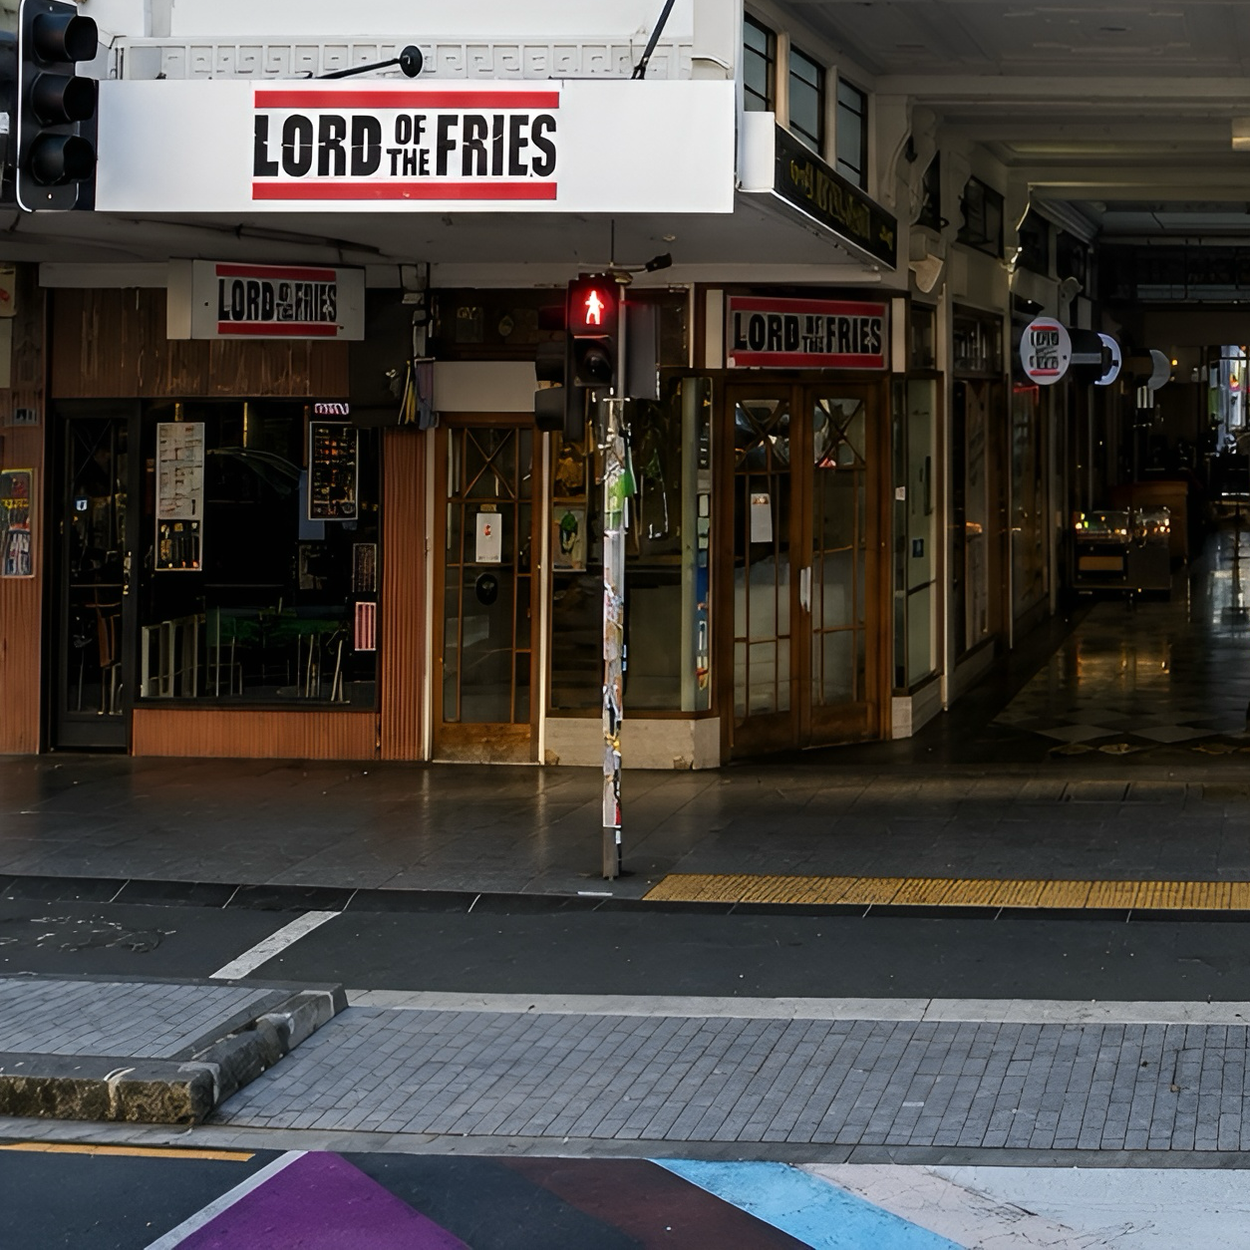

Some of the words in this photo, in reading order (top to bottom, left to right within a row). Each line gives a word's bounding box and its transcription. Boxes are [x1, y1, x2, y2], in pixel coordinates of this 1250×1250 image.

[253, 114, 383, 178] LORD
[395, 113, 427, 146] OF
[435, 113, 557, 178] FRIES
[386, 148, 431, 177] THE
[218, 278, 275, 322] LORD
[734, 312, 800, 352] LORD
[826, 316, 883, 354] FRIES
